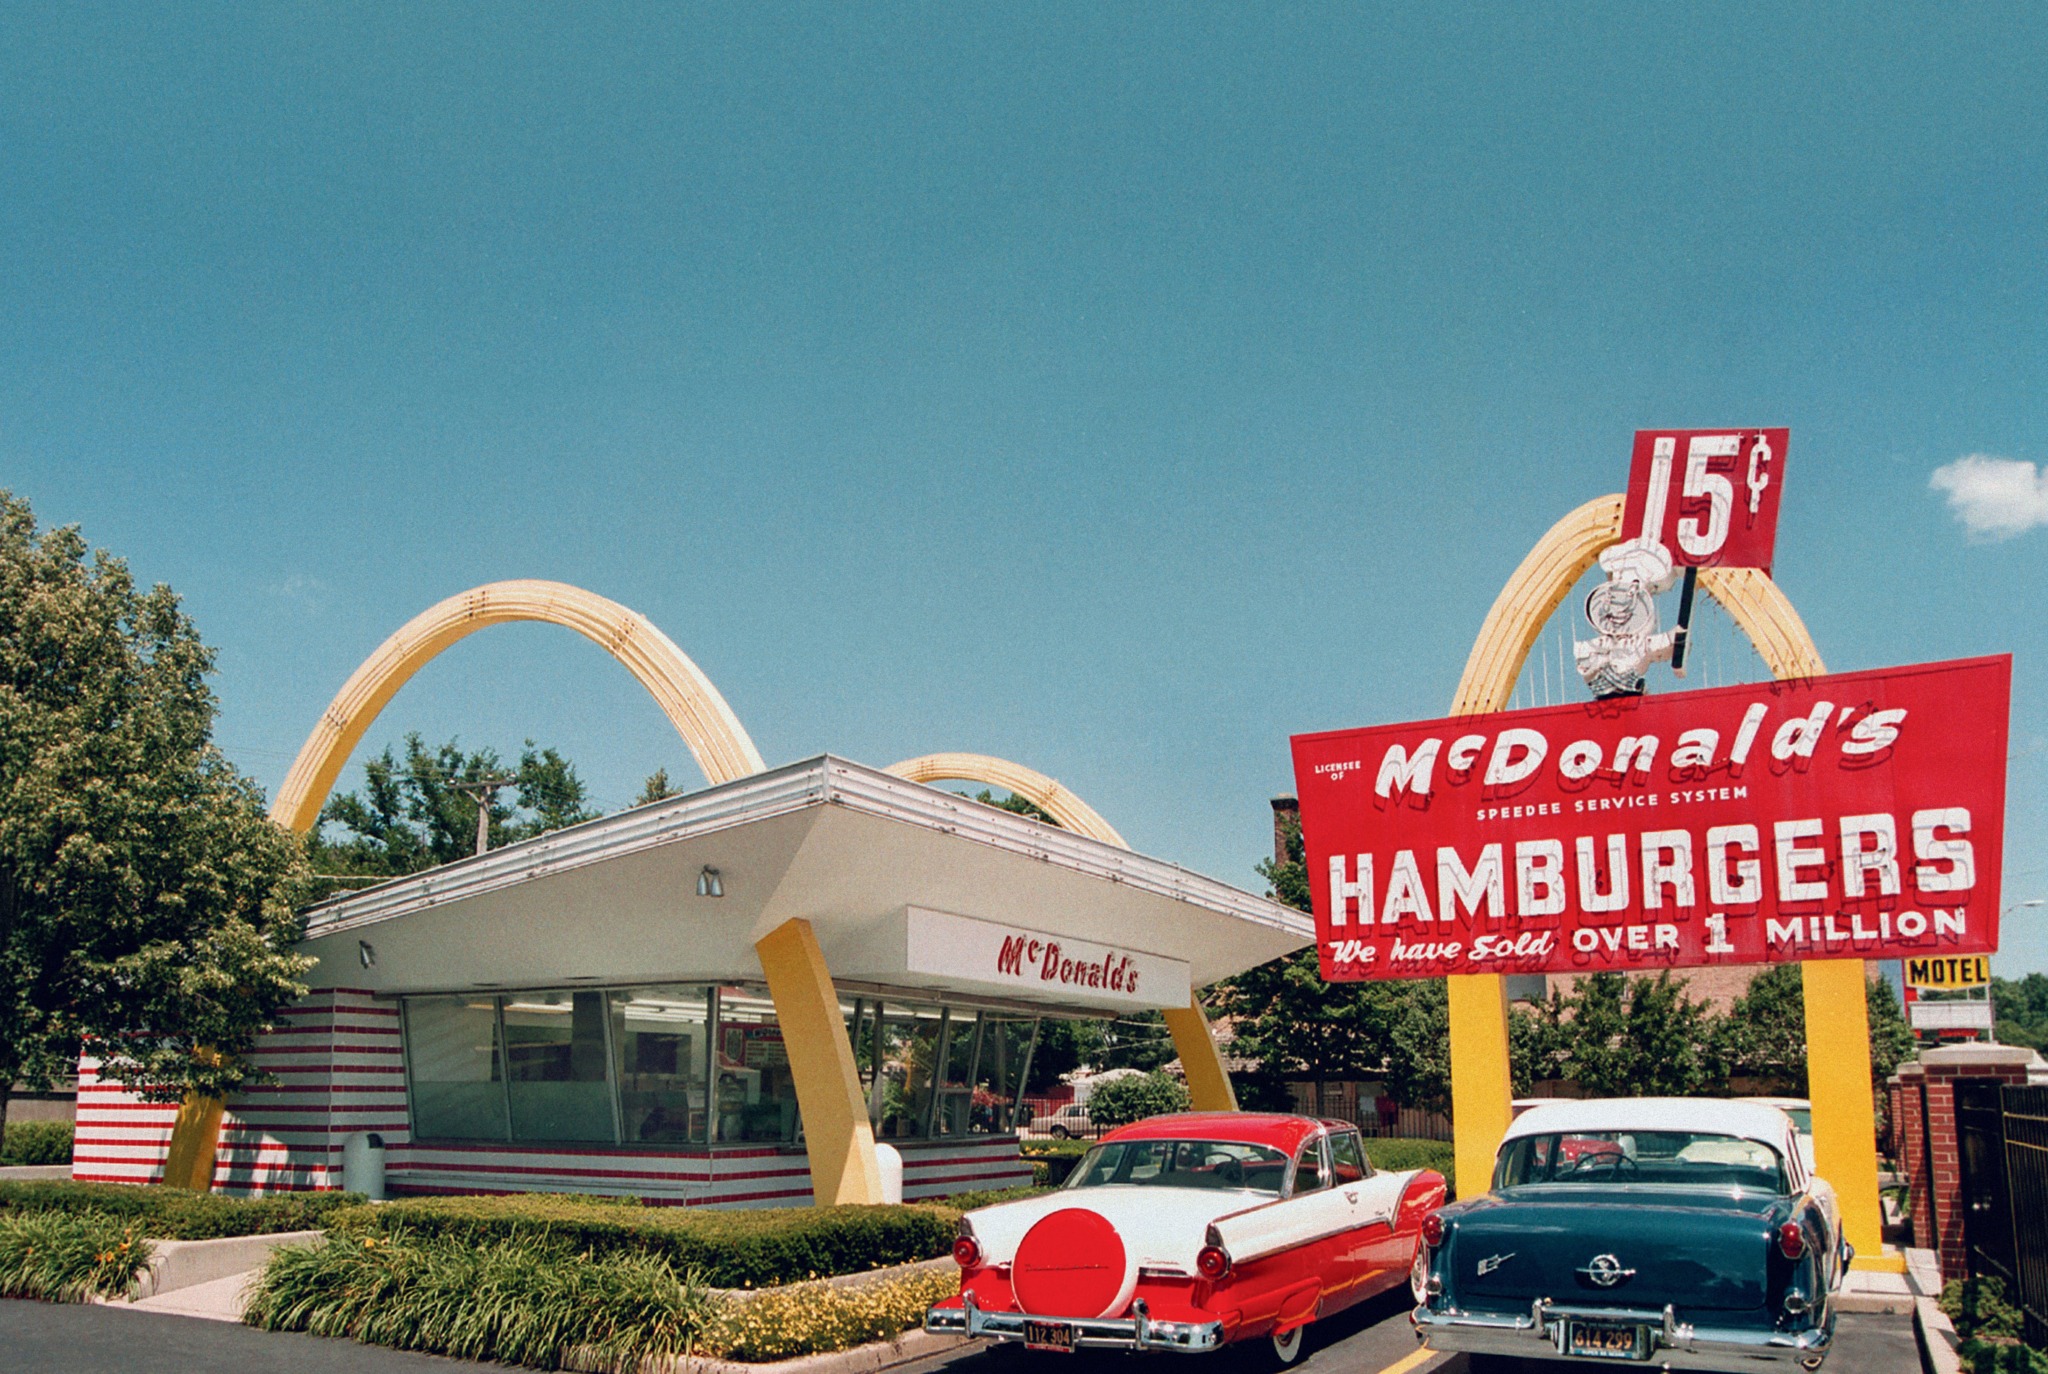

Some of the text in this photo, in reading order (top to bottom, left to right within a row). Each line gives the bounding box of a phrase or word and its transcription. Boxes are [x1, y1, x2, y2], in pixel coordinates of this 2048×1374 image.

[1641, 434, 1772, 556] 15¢
[1315, 760, 1361, 774] LICENSEE
[1374, 701, 1908, 798] McDonald's
[1331, 772, 1344, 781] OF
[1477, 786, 1747, 821] SPEEDEE SERVICE SYSTEM
[1329, 807, 1976, 926] HAMBURGERS
[1329, 939, 1376, 963] We
[1390, 937, 1462, 961] have
[1573, 923, 1680, 952] OVER
[1704, 912, 1735, 953] 1
[1765, 907, 1966, 943] MILLION
[1909, 958, 1987, 984] MOTEL
